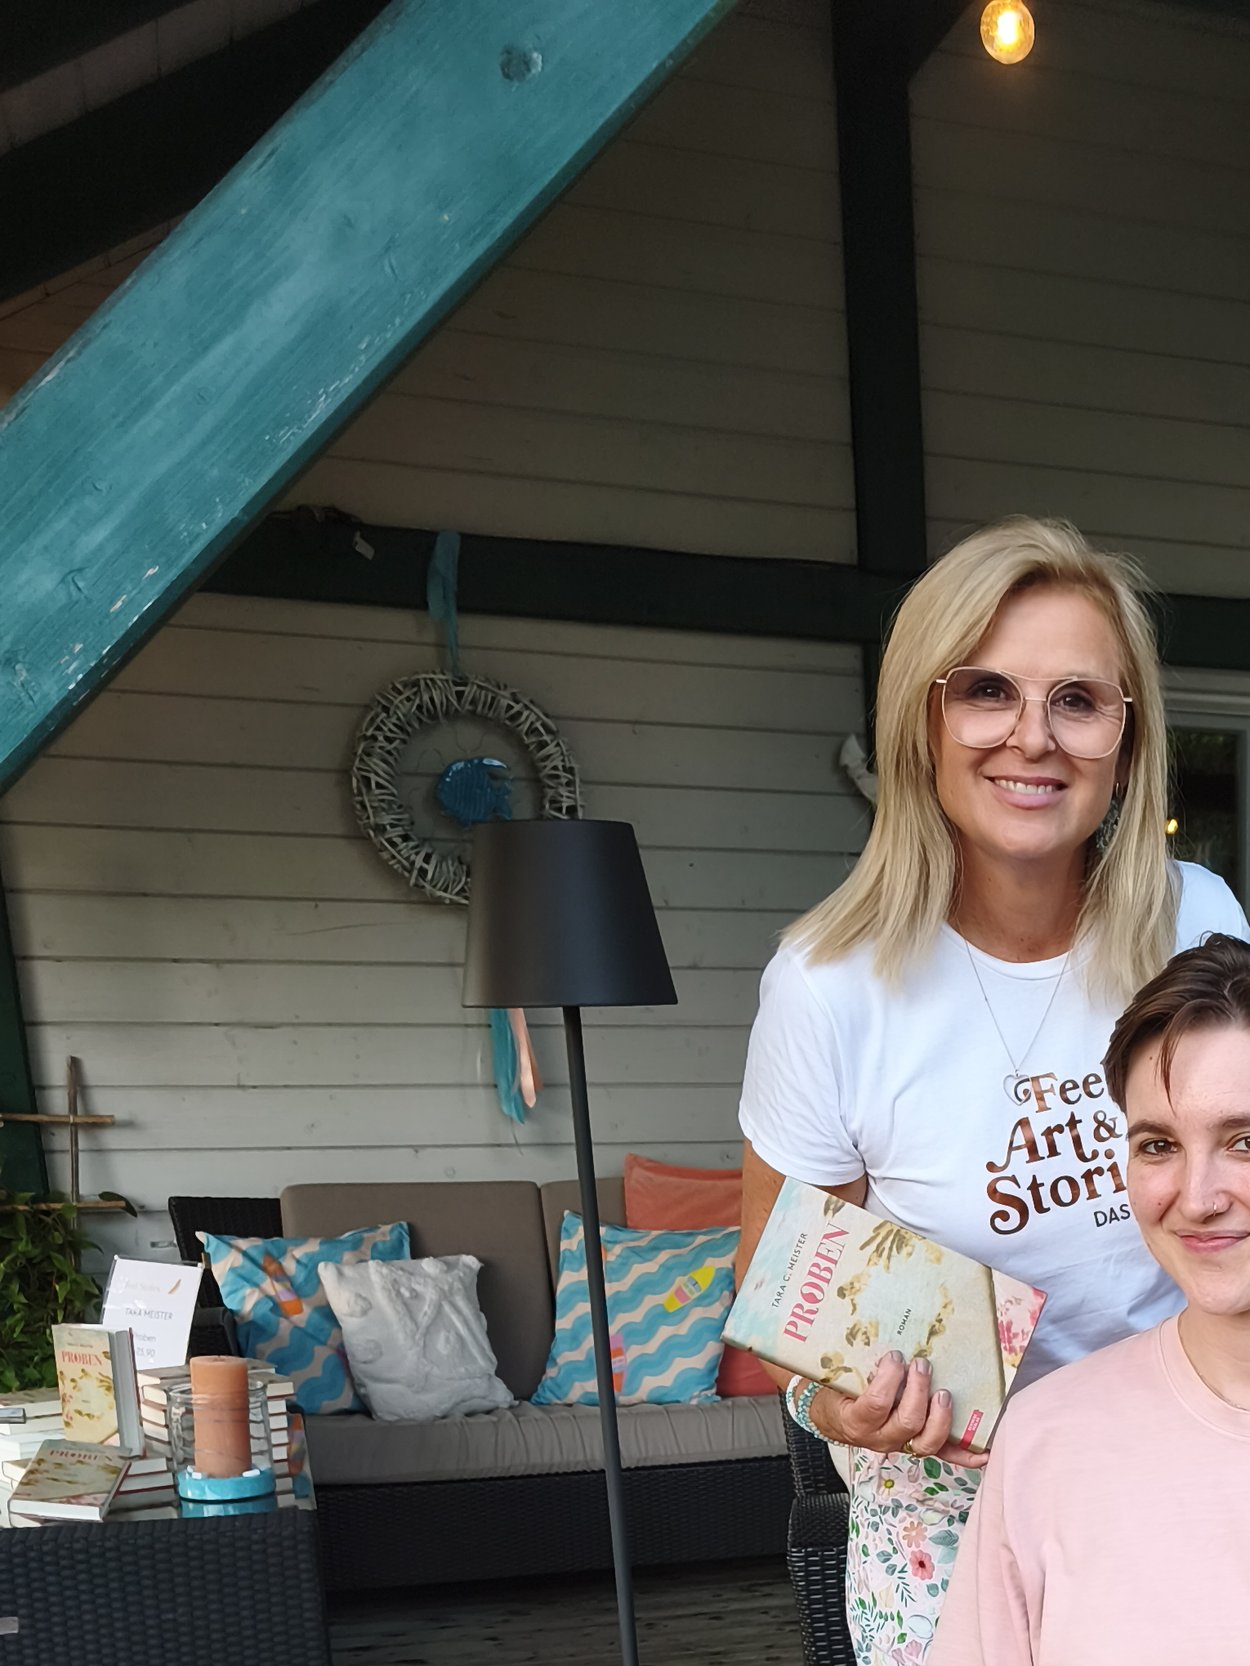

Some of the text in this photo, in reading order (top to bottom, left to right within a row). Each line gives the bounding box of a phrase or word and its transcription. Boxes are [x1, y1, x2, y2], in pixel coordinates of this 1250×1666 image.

[1013, 1071, 1106, 1114] Fee
[985, 1109, 1123, 1173] Art &
[986, 1148, 1128, 1235] Stori
[1093, 1203, 1131, 1228] DAS
[771, 1284, 787, 1309] TARA
[788, 1232, 809, 1272] MEISTER
[783, 1222, 850, 1343] PROBEN
[143, 1309, 174, 1321] MEISTER
[896, 1307, 912, 1336] ROMAN
[61, 1350, 103, 1366] PROBEN
